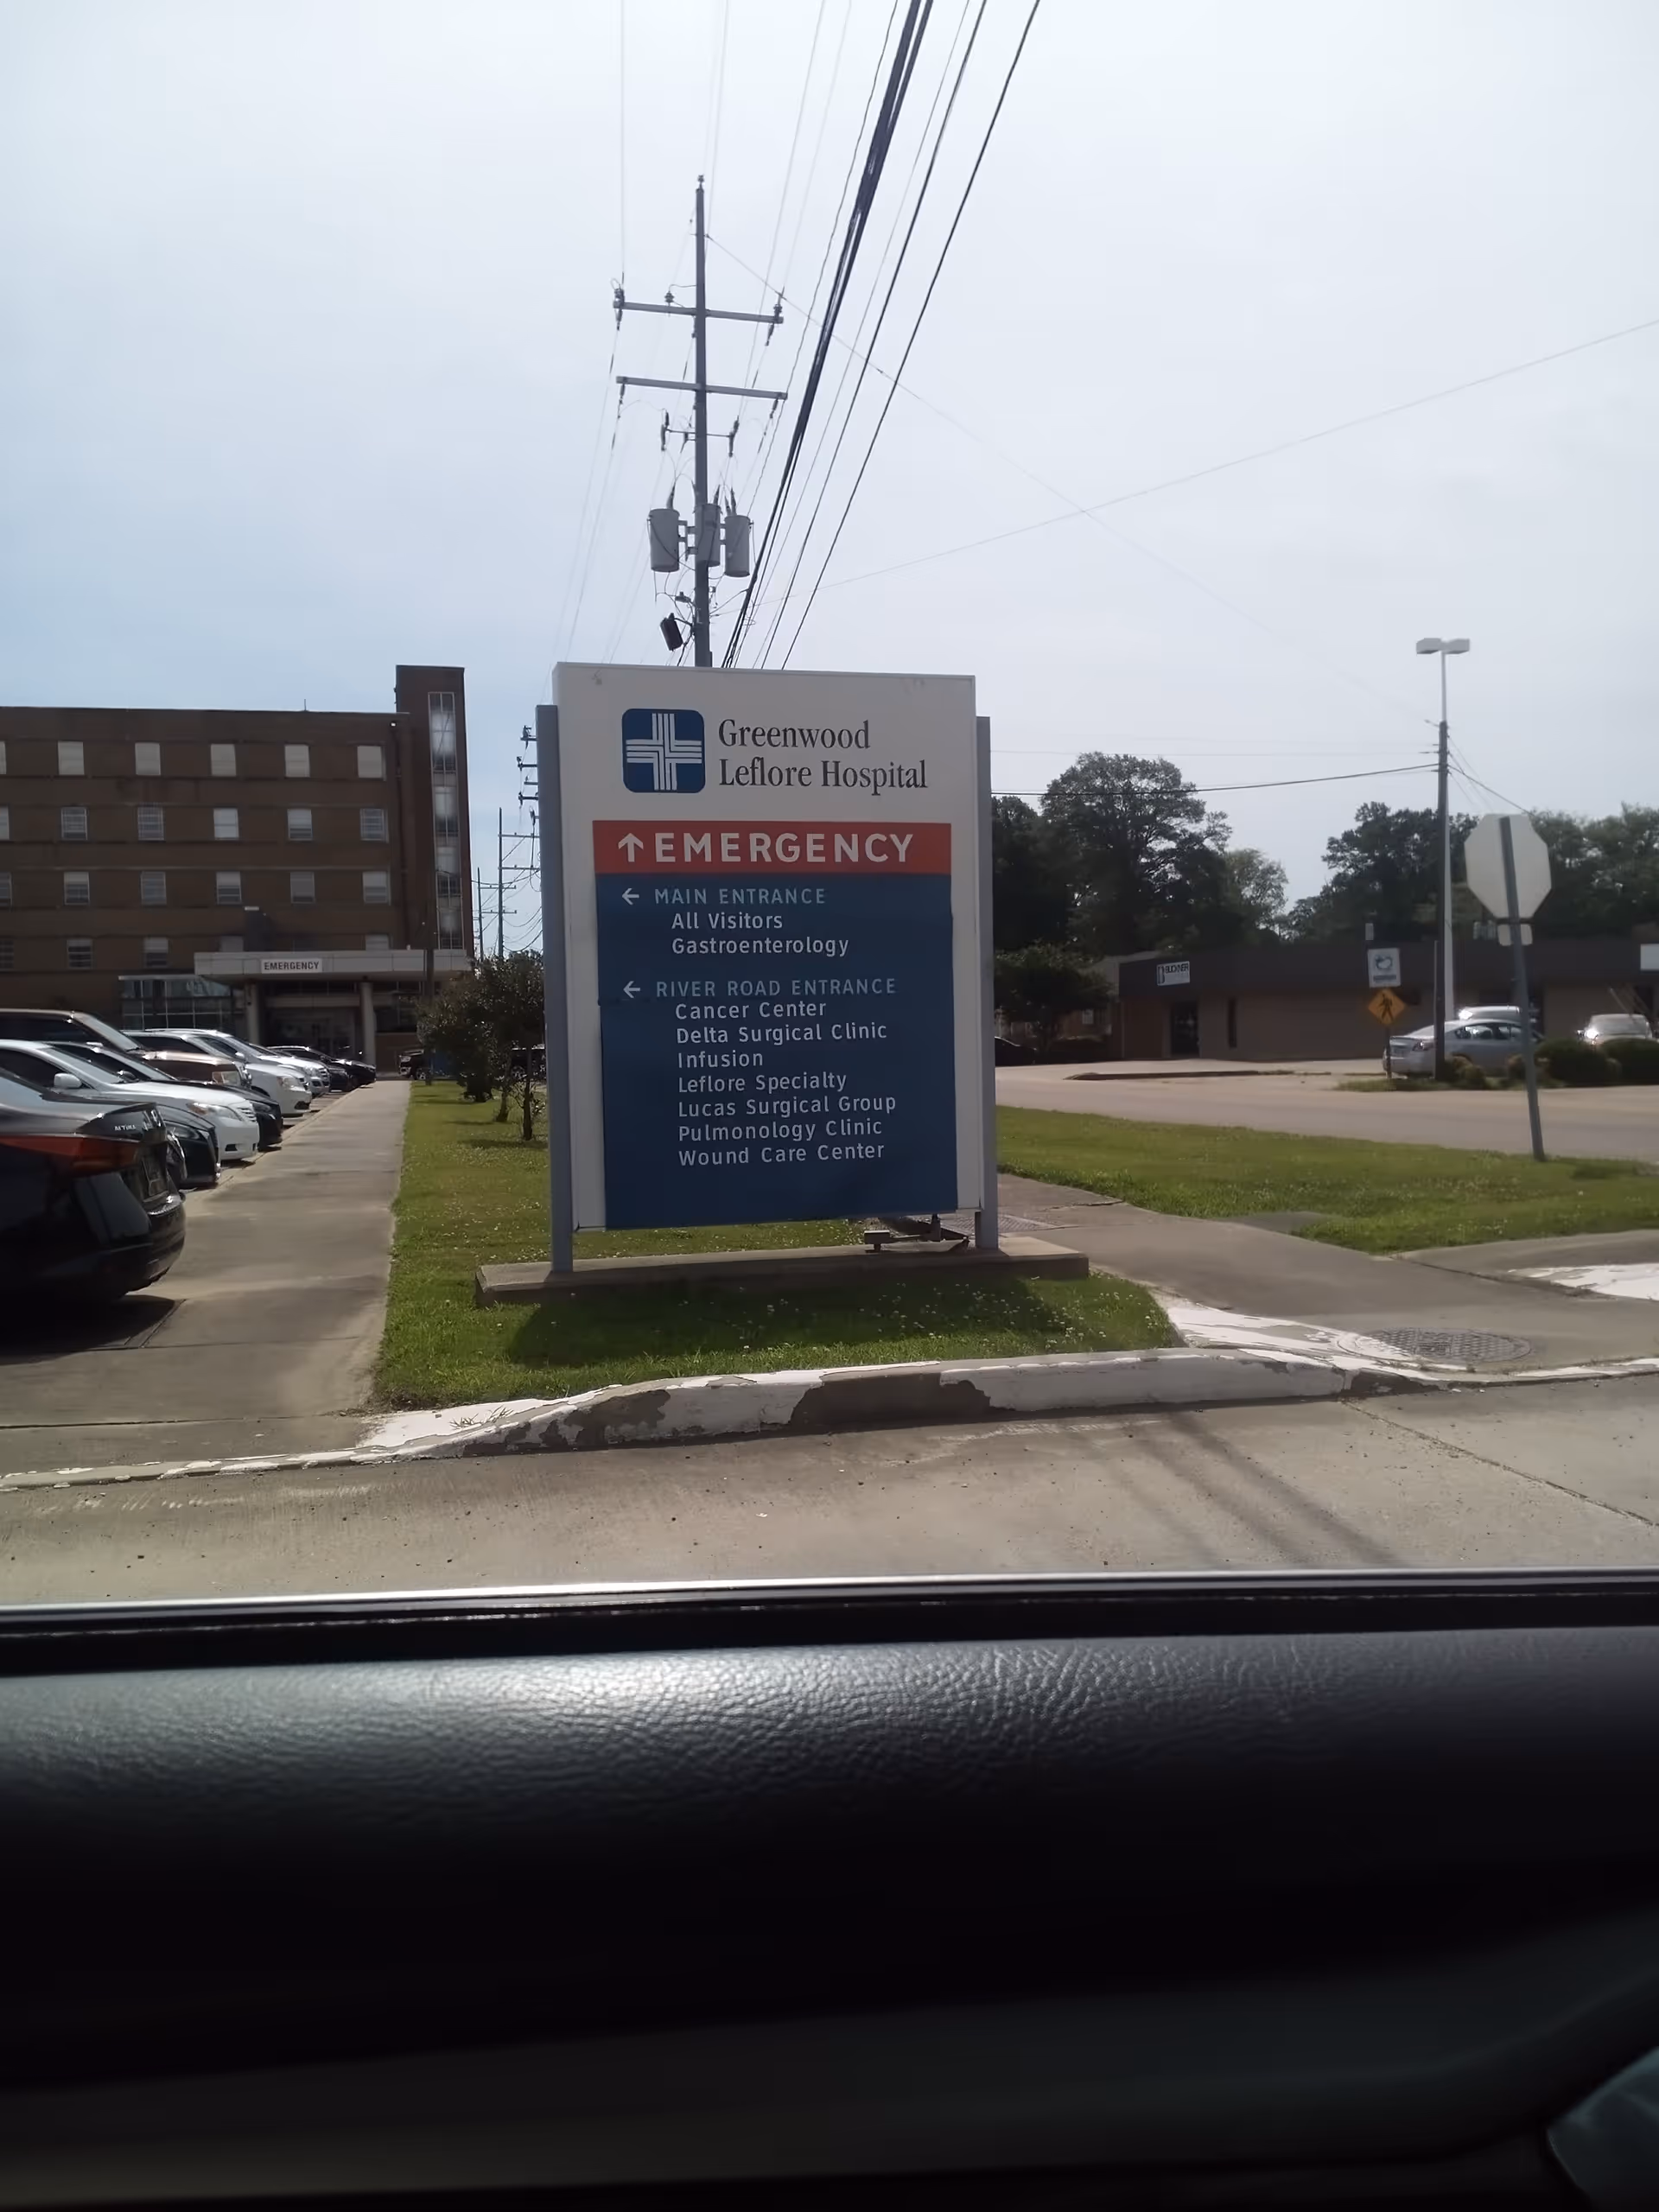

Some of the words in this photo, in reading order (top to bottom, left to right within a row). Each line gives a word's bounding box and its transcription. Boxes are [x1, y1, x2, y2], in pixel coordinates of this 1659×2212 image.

[718, 719, 871, 749] Greenwood
[719, 756, 812, 787] Leflore
[821, 759, 928, 797] Hospital
[654, 832, 913, 863] EMERGENCY
[654, 888, 707, 905] MAIN
[719, 887, 825, 905] ENTRANCE
[671, 912, 699, 930] All
[708, 911, 783, 930] Visitors
[671, 936, 849, 957] Gastroenterology
[264, 961, 320, 970] EMERGENCY
[656, 981, 715, 998] RIVER
[728, 980, 780, 996] ROAD
[791, 977, 895, 995] ENTRANCE
[675, 1003, 750, 1020] Cancer
[759, 1001, 827, 1018] Center
[677, 1027, 728, 1044] Delta
[738, 1023, 822, 1046] Surgical
[831, 1021, 887, 1040] Clinic
[678, 1049, 763, 1069] Infusion
[678, 1075, 746, 1093] Leflore
[755, 1071, 847, 1095] Specialty
[678, 1102, 736, 1117] Lucas
[746, 1095, 830, 1118] Surgical
[838, 1096, 896, 1115] Group
[679, 1121, 816, 1141] Pulmonology
[825, 1117, 882, 1136] Clinic
[678, 1147, 749, 1166] Wound
[761, 1147, 807, 1163] Care
[817, 1142, 885, 1160] Center
